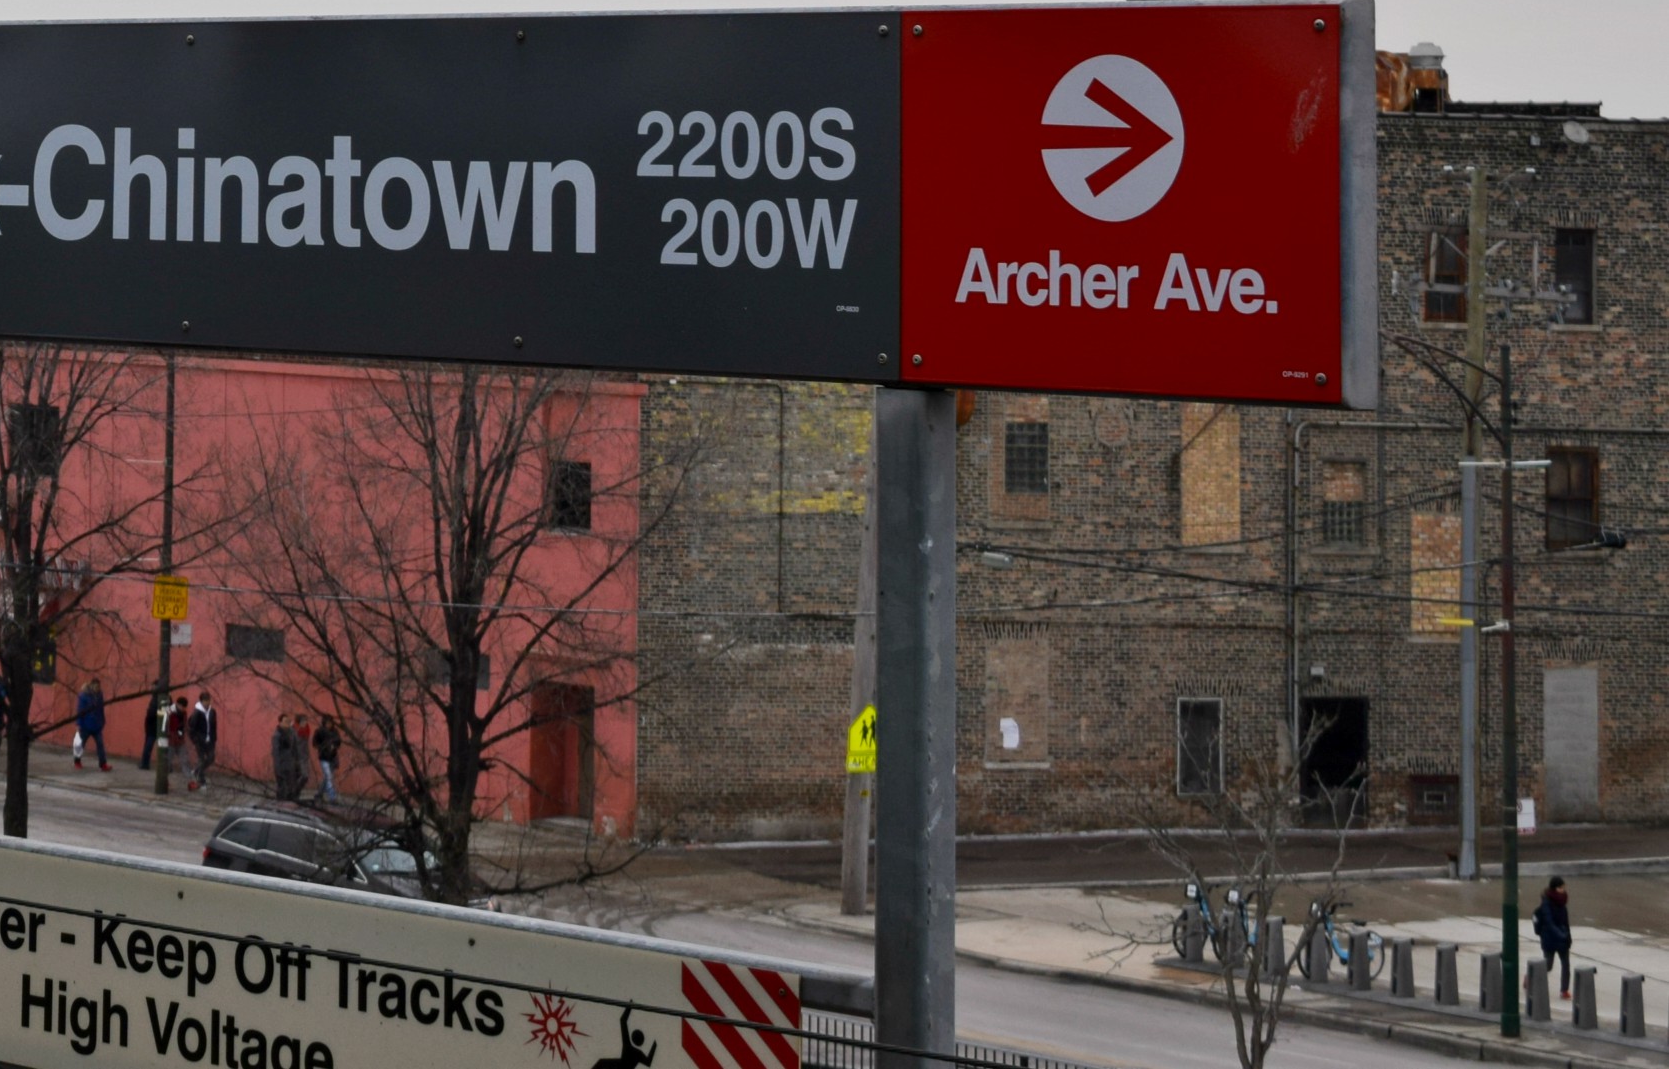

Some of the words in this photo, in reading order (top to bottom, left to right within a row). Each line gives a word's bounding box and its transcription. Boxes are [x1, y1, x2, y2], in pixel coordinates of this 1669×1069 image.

[636, 107, 856, 181] 2200S
[660, 198, 858, 269] 200W
[955, 247, 1139, 309] Archer
[1153, 253, 1278, 314] Ave.
[93, 909, 216, 997] Keep
[234, 935, 311, 1001] Off
[327, 949, 505, 1036] Tracks
[21, 973, 129, 1056] High
[146, 996, 333, 1069] Voltage
